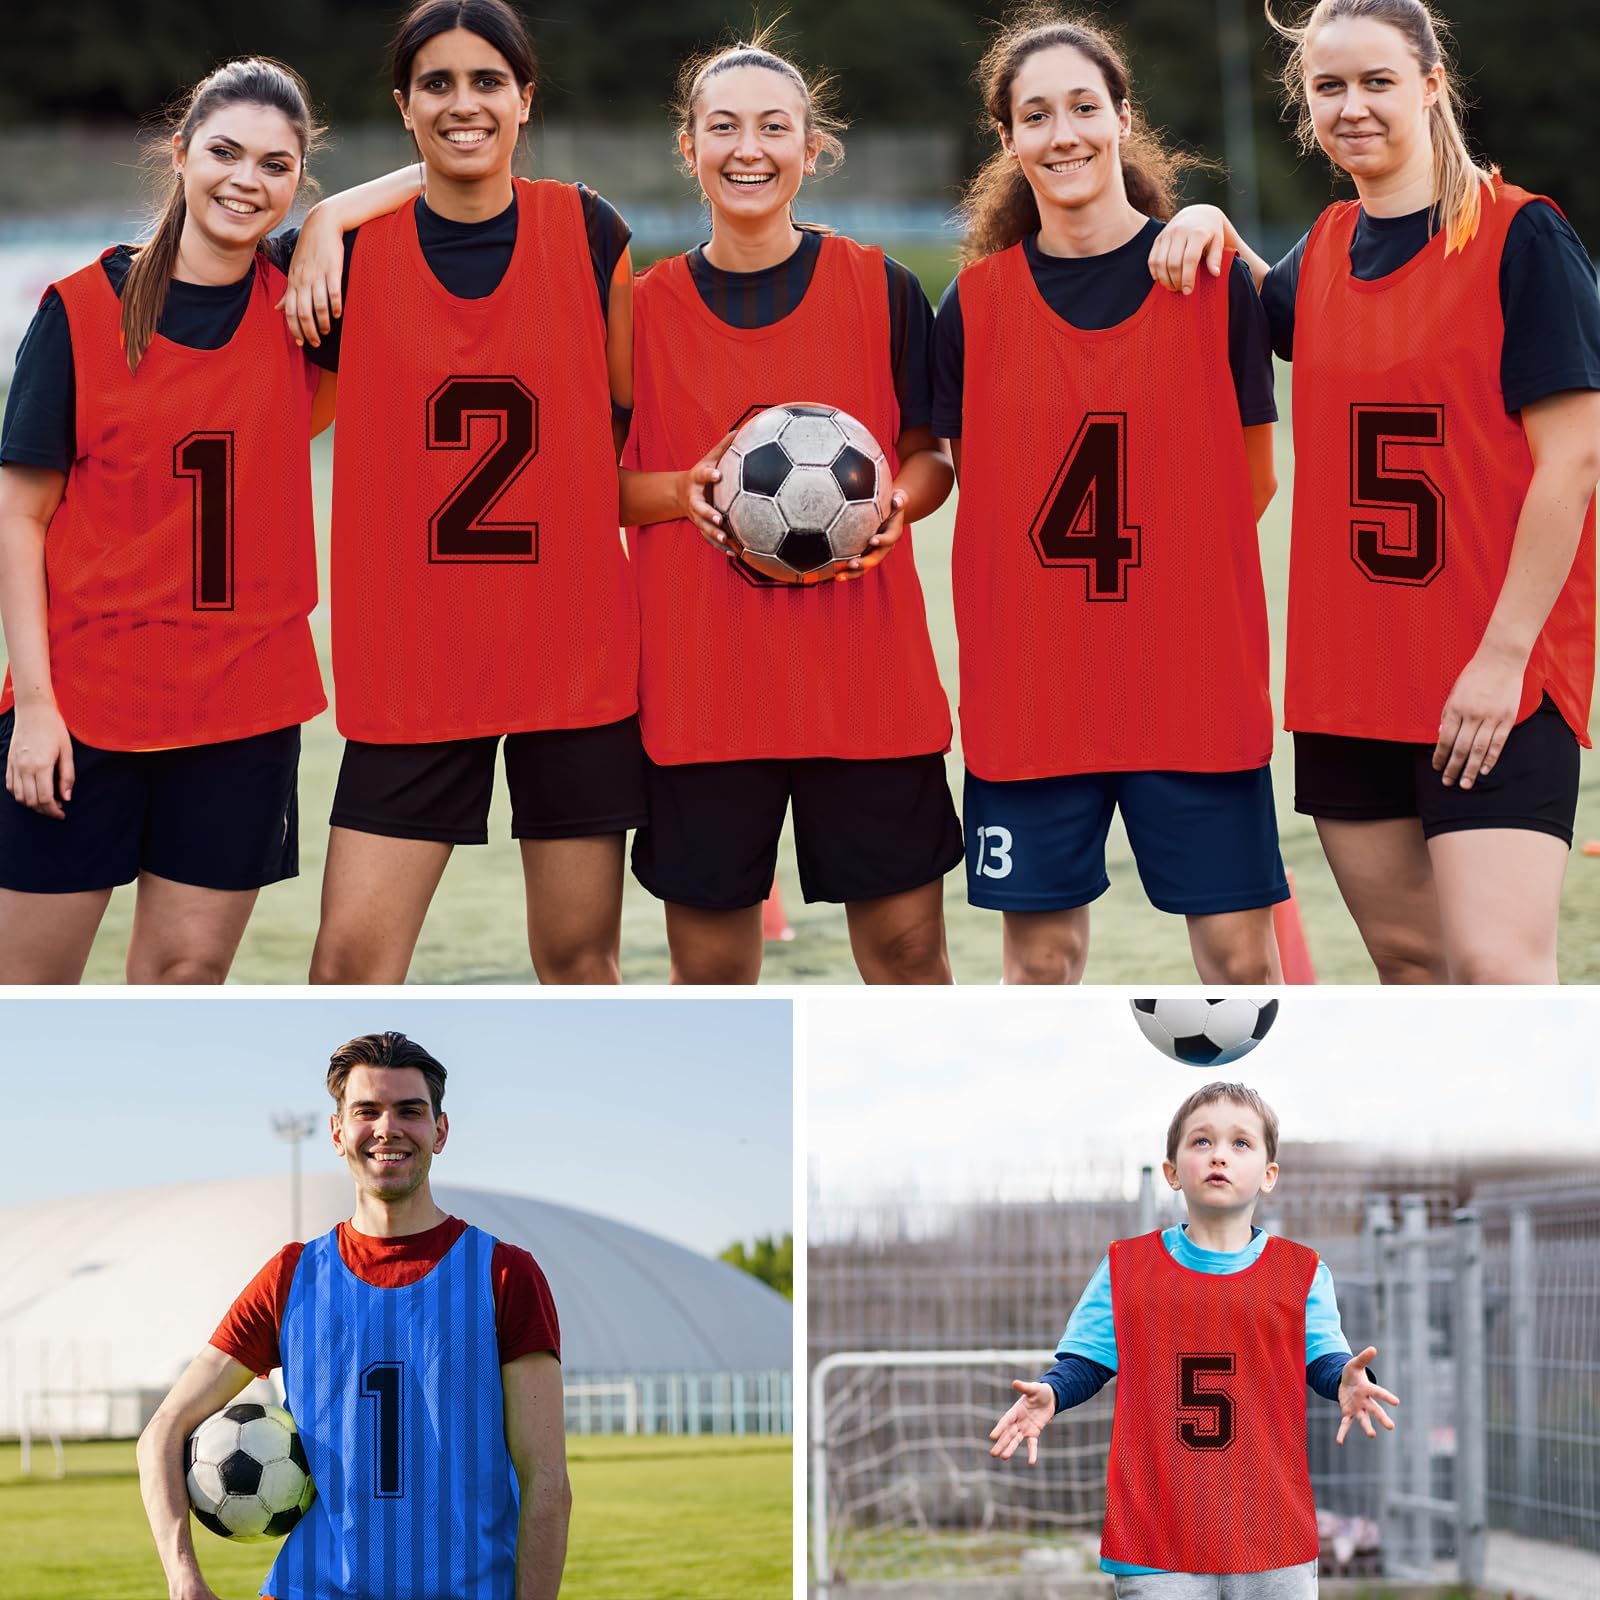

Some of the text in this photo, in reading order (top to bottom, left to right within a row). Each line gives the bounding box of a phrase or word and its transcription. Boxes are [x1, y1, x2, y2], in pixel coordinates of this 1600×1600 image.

[172, 430, 235, 611] 1
[426, 375, 539, 564] 2
[1028, 411, 1142, 603] 4
[1350, 403, 1446, 587] 5
[976, 826, 1012, 879] 13
[359, 1361, 405, 1499] 1
[1175, 1352, 1236, 1452] 5
